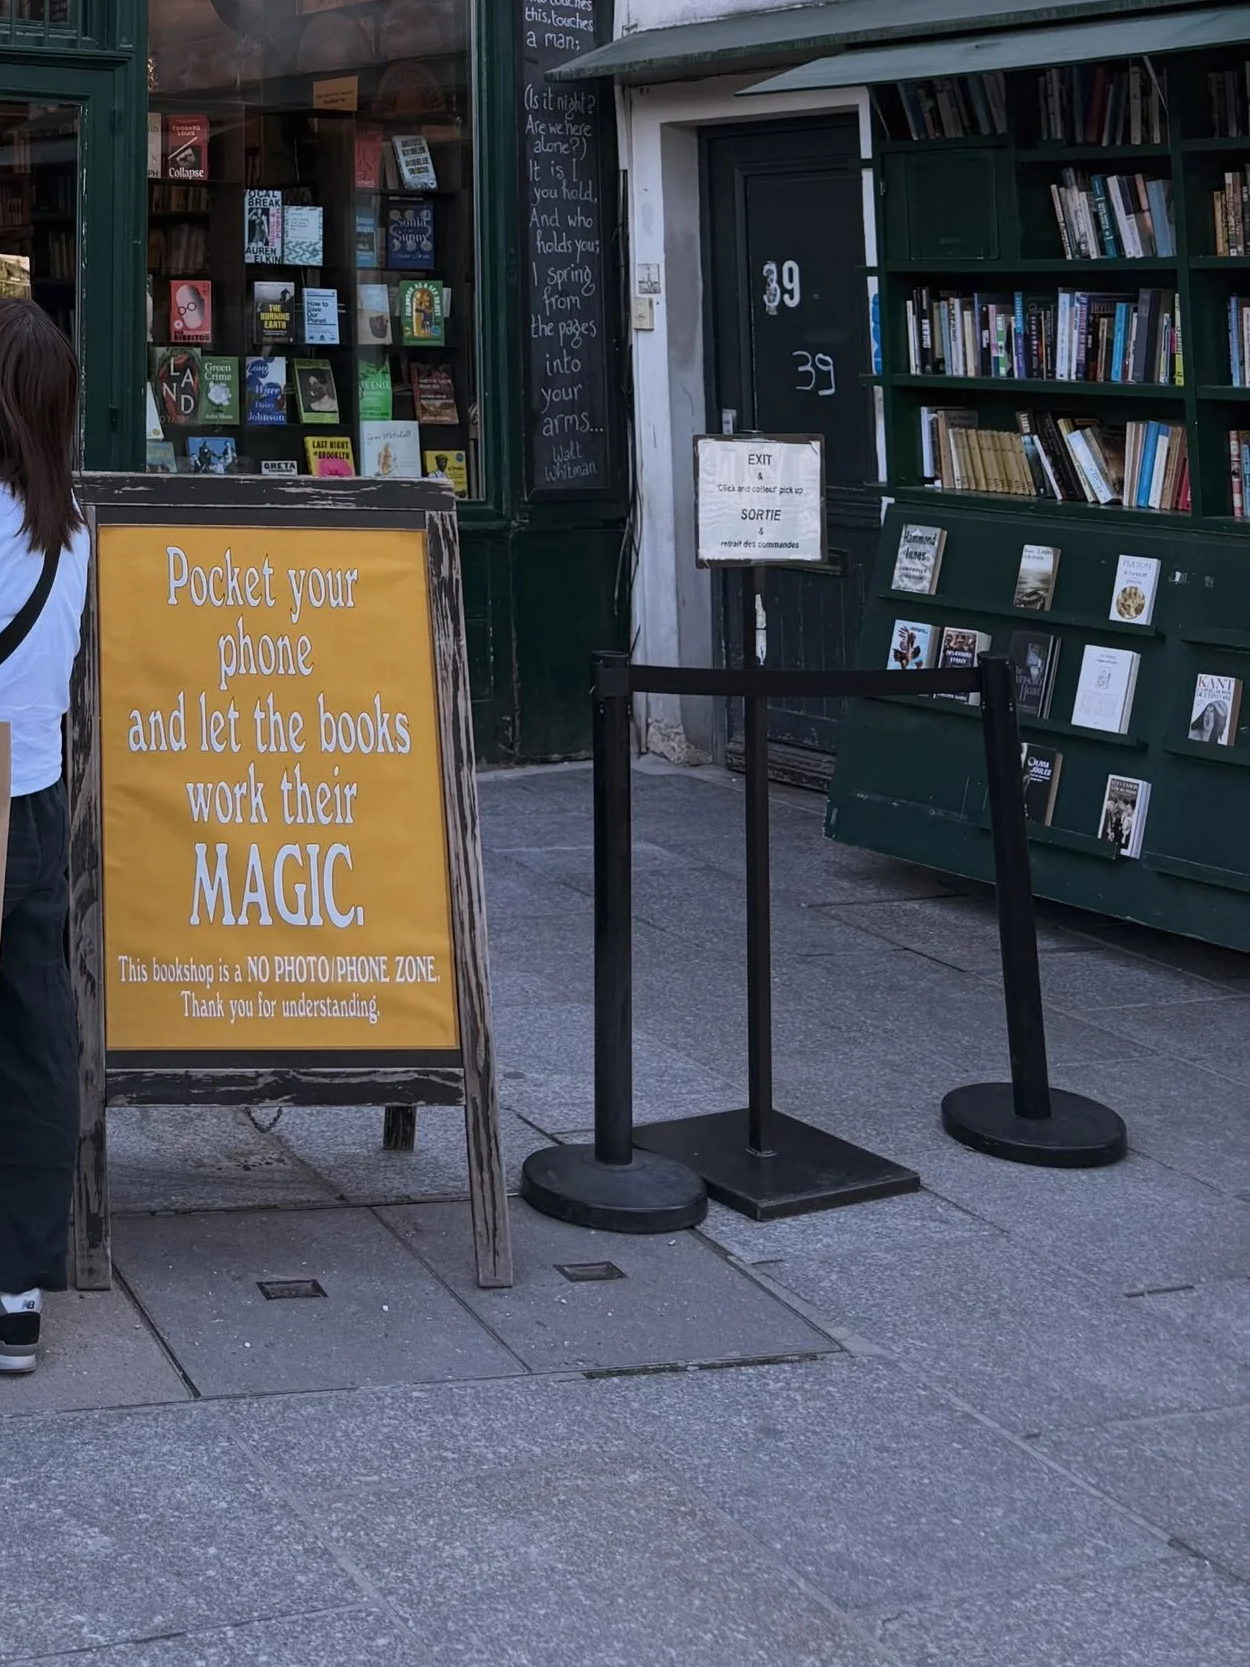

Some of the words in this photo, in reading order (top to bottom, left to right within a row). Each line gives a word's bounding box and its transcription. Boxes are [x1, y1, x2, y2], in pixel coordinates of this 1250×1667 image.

[526, 31, 537, 48] a
[545, 33, 580, 51] man;
[543, 86, 554, 111] it
[525, 114, 546, 135] Are
[548, 121, 564, 135] we
[564, 119, 592, 137] here
[533, 135, 587, 161] alone?)
[168, 166, 205, 180] Collapse
[529, 159, 541, 182] It
[550, 160, 565, 180] is
[248, 198, 281, 207] BREAK
[531, 187, 558, 207] you
[561, 178, 598, 204] hold,
[528, 207, 560, 228] And
[567, 205, 593, 228] who
[536, 229, 573, 254] holds
[574, 237, 600, 264] you;
[547, 263, 596, 297] spring
[762, 259, 801, 310] 39
[542, 285, 581, 317] from
[530, 314, 555, 338] the
[558, 318, 597, 349] pages
[204, 362, 232, 372] Green
[545, 348, 582, 376] into
[791, 350, 836, 396] 39
[204, 371, 232, 381] Crime
[540, 383, 583, 415] your
[247, 411, 285, 421] Johnson
[312, 440, 328, 449] LAST
[748, 453, 772, 466] EXIT
[757, 472, 763, 480] &
[779, 486, 793, 496] pick
[740, 508, 782, 521] SORTIE
[743, 540, 756, 548] des
[758, 540, 799, 549] commandes
[166, 546, 276, 608] Pocket
[288, 566, 359, 624] your
[217, 615, 315, 691] phone
[1198, 675, 1233, 690] KANT
[128, 691, 188, 753] and
[198, 691, 241, 753] let
[253, 691, 307, 754] the
[317, 691, 412, 755] books
[185, 760, 269, 825] work
[280, 761, 359, 825] their
[189, 841, 366, 928] MAGIC.
[117, 954, 148, 983] This
[152, 957, 215, 989] bookshop
[218, 958, 231, 983] is
[234, 965, 243, 983] a
[247, 956, 270, 983] NO
[274, 955, 391, 983] PHOTO/PHONE
[394, 955, 442, 983] ZONE.
[180, 990, 225, 1018] Thank
[229, 999, 254, 1025] you
[257, 991, 277, 1018] for
[281, 991, 381, 1025] understanding.
